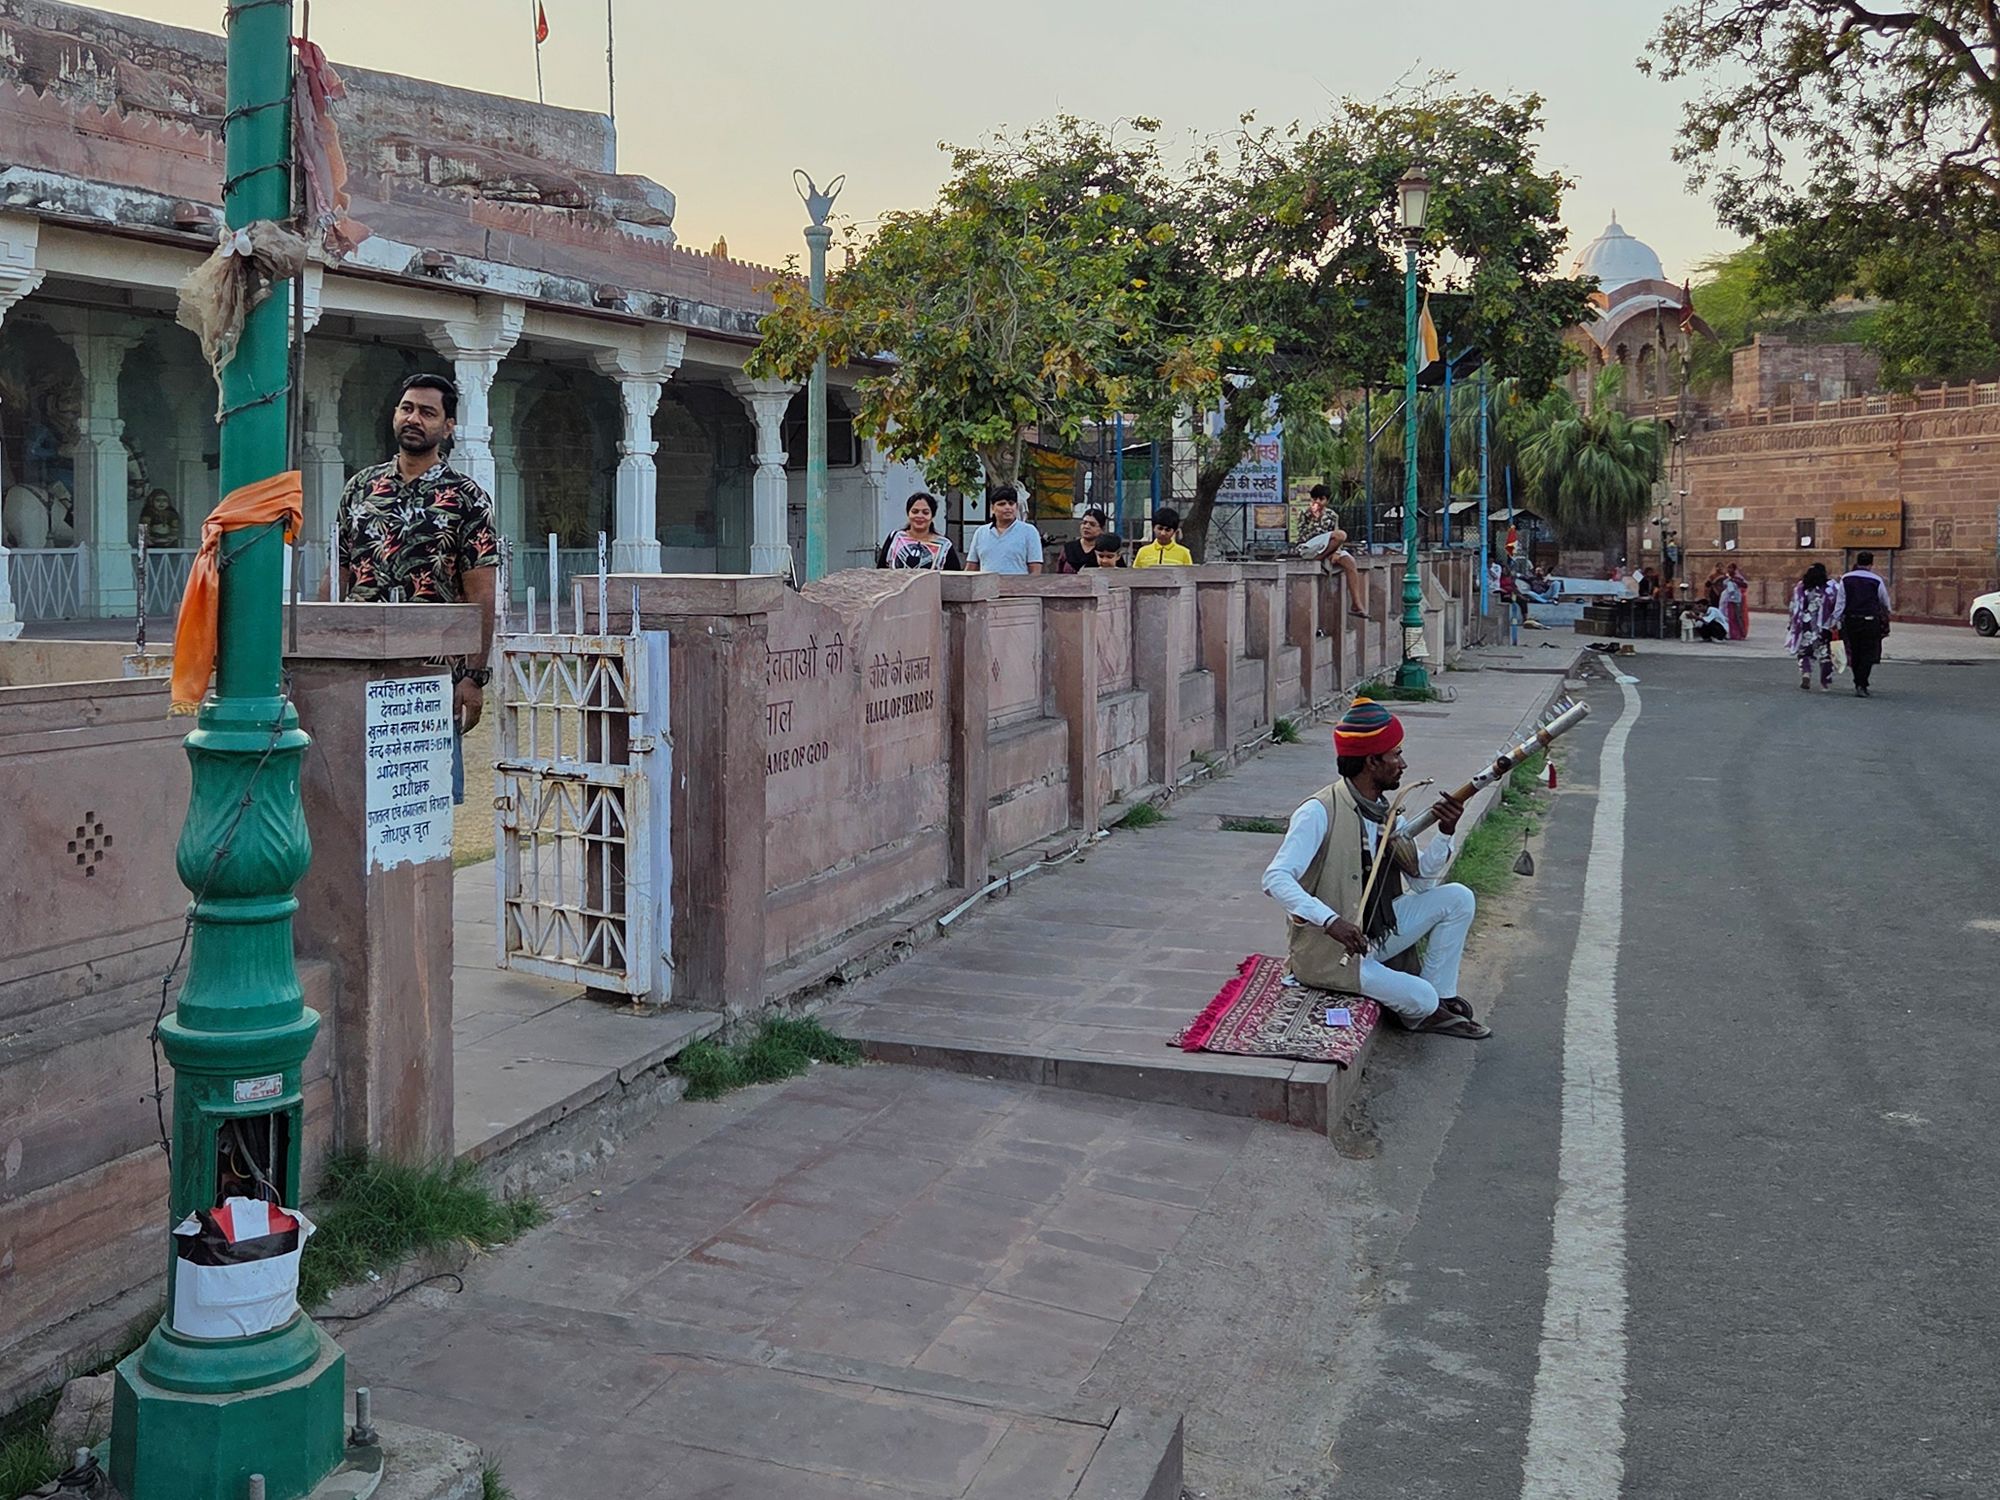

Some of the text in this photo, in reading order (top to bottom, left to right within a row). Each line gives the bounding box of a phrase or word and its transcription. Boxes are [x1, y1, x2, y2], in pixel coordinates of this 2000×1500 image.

[1237, 475, 1250, 490] की
[825, 632, 844, 675] की
[407, 680, 440, 695] स्मारक
[865, 689, 934, 724] HALL OF HEROES
[390, 723, 399, 736] का
[400, 721, 420, 735] समय
[791, 746, 806, 768] OF
[806, 741, 829, 764] GOD
[380, 824, 411, 844] जोधपुर
